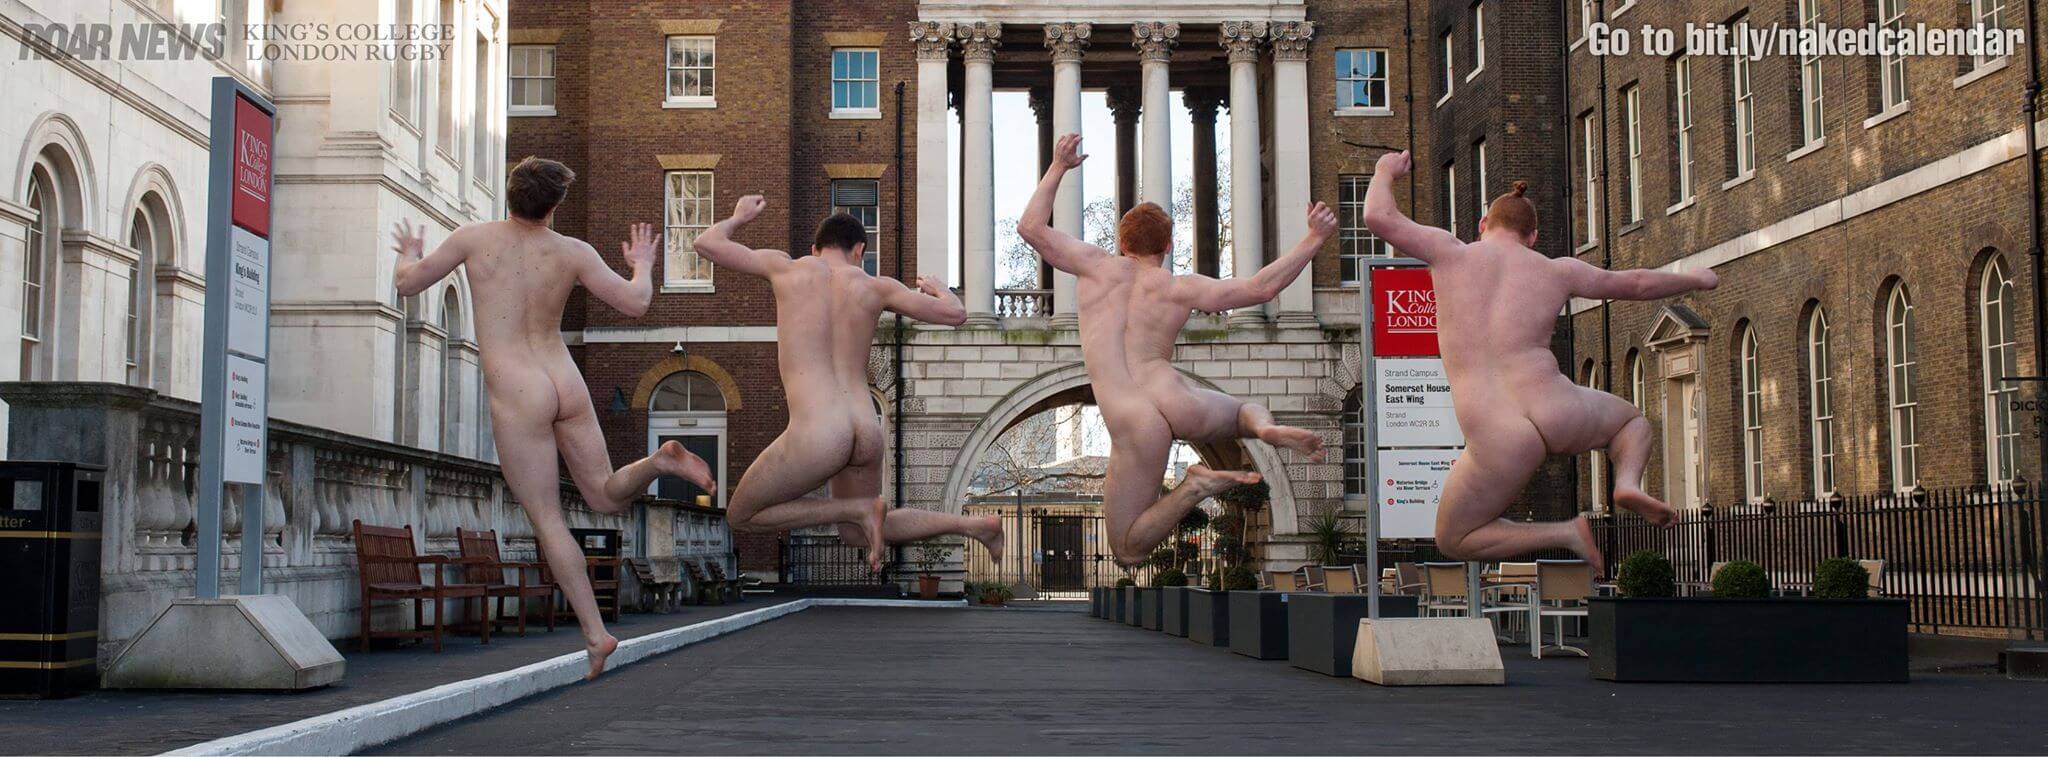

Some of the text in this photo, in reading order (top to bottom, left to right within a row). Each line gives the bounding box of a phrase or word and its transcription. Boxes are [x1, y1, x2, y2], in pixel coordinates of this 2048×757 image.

[240, 166, 267, 193] LONDON
[1385, 290, 1436, 314] KING
[1408, 302, 1436, 314] Colle
[1387, 316, 1438, 327] LONDO
[1384, 369, 1439, 378] Strand Campus
[1385, 384, 1451, 392] Somerset House
[1385, 395, 1424, 405] East Wing
[2010, 401, 2048, 411] DICK
[0, 516, 26, 528] tter
